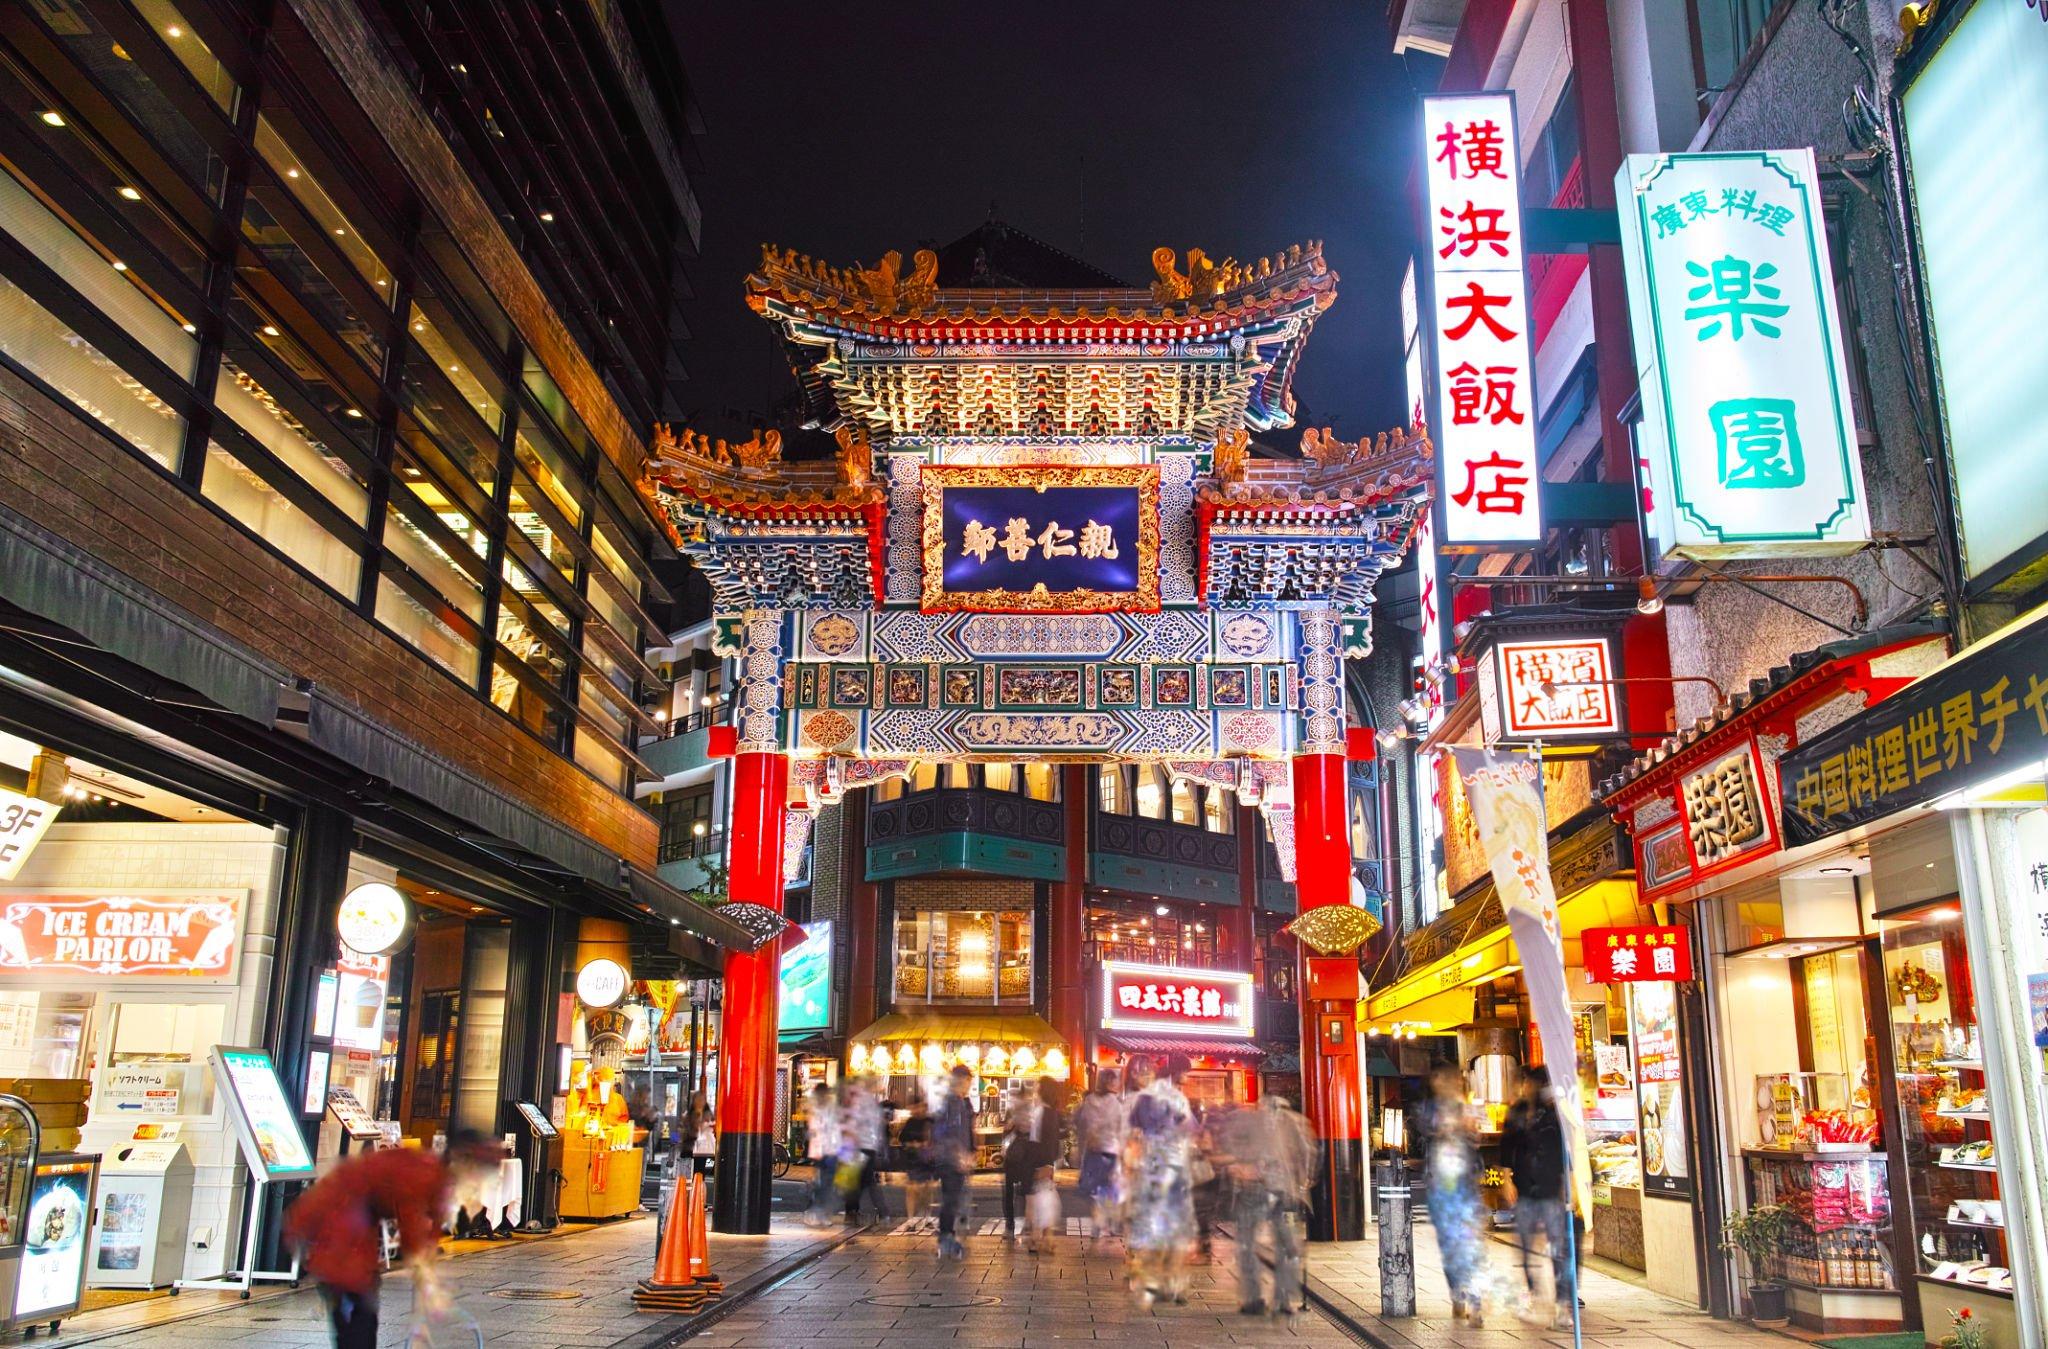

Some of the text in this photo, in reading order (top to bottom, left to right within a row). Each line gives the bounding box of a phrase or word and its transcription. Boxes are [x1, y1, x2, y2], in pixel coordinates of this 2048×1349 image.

[1650, 187, 1796, 240] 廣東料理
[1436, 119, 1529, 516] 横浜大飯店
[1684, 254, 1807, 490] 楽園
[41, 910, 190, 938] ICE CREAM
[53, 936, 174, 963] PARLOR
[119, 1075, 162, 1085] ソフトクリーム
